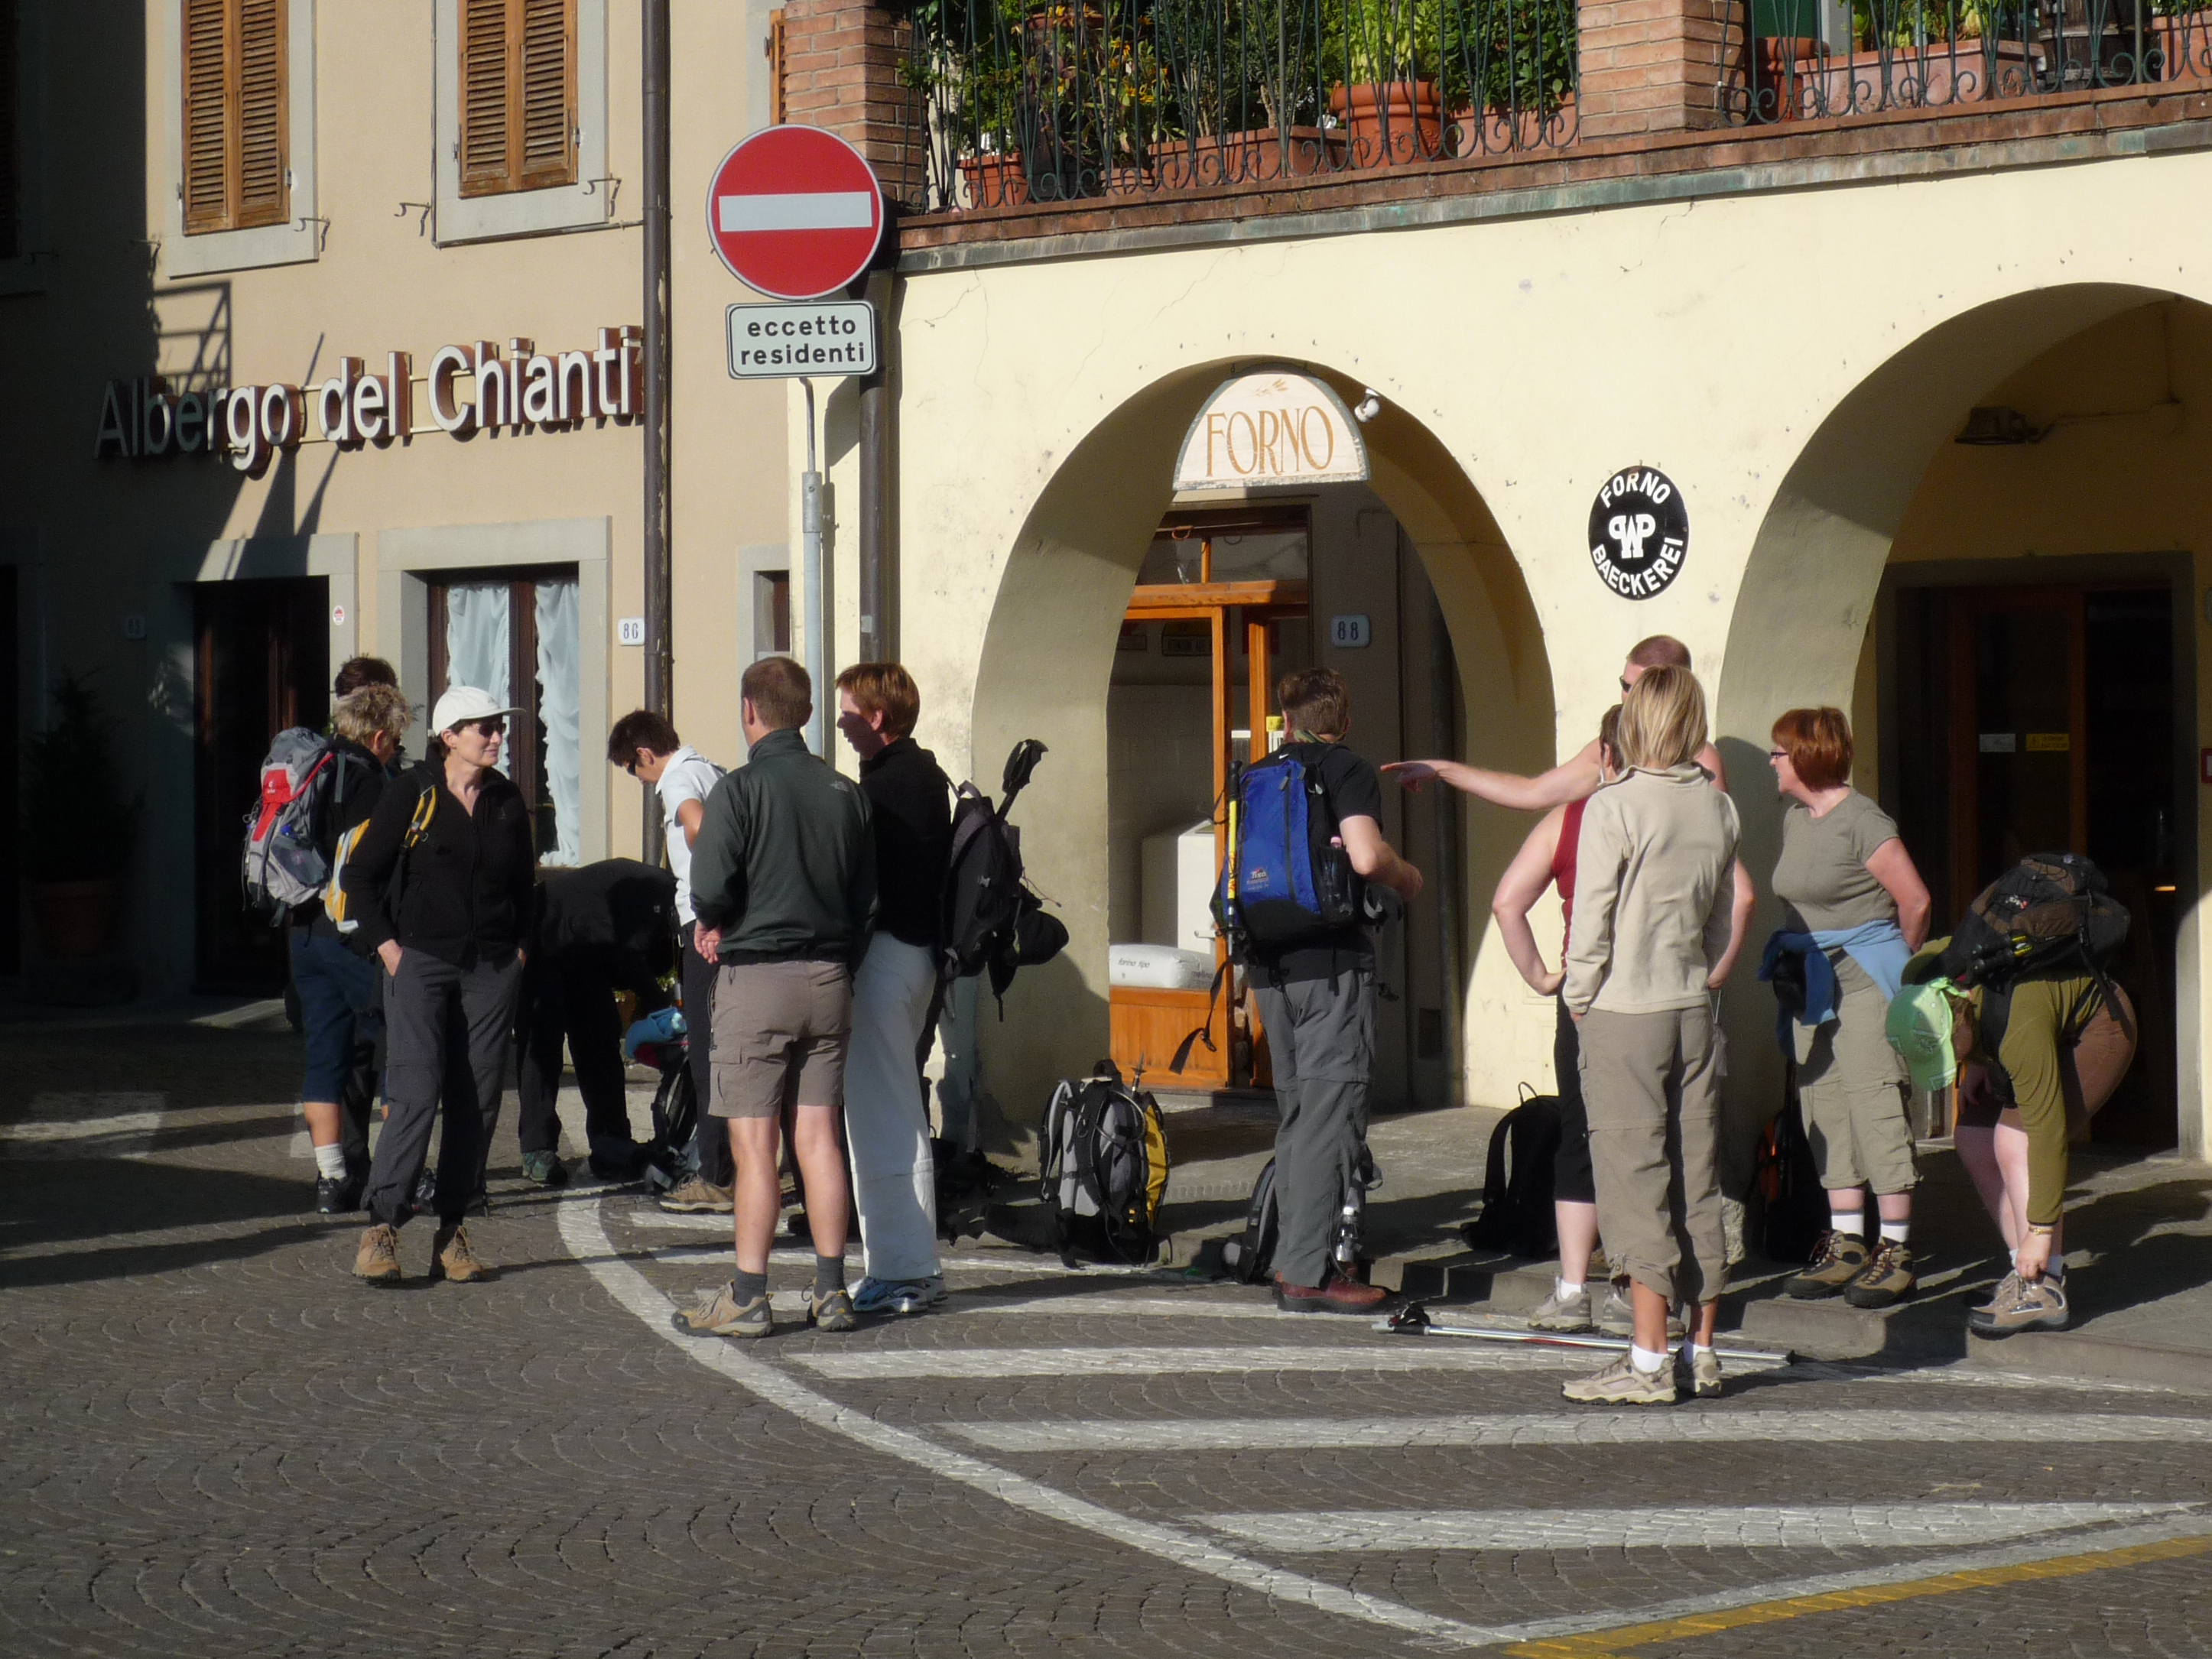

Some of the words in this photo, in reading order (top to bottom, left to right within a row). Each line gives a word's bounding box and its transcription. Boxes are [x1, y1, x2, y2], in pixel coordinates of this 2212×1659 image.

[747, 315, 856, 337] eccetto
[740, 342, 865, 365] residenti
[94, 378, 291, 471] Albergo
[318, 351, 406, 442] del
[428, 325, 629, 432] Chianti
[1205, 405, 1334, 477] FORNO
[1600, 472, 1671, 508] FORNO
[1592, 537, 1684, 596] BAECKEREI
[623, 622, 638, 639] 86
[1338, 621, 1359, 641] 88
